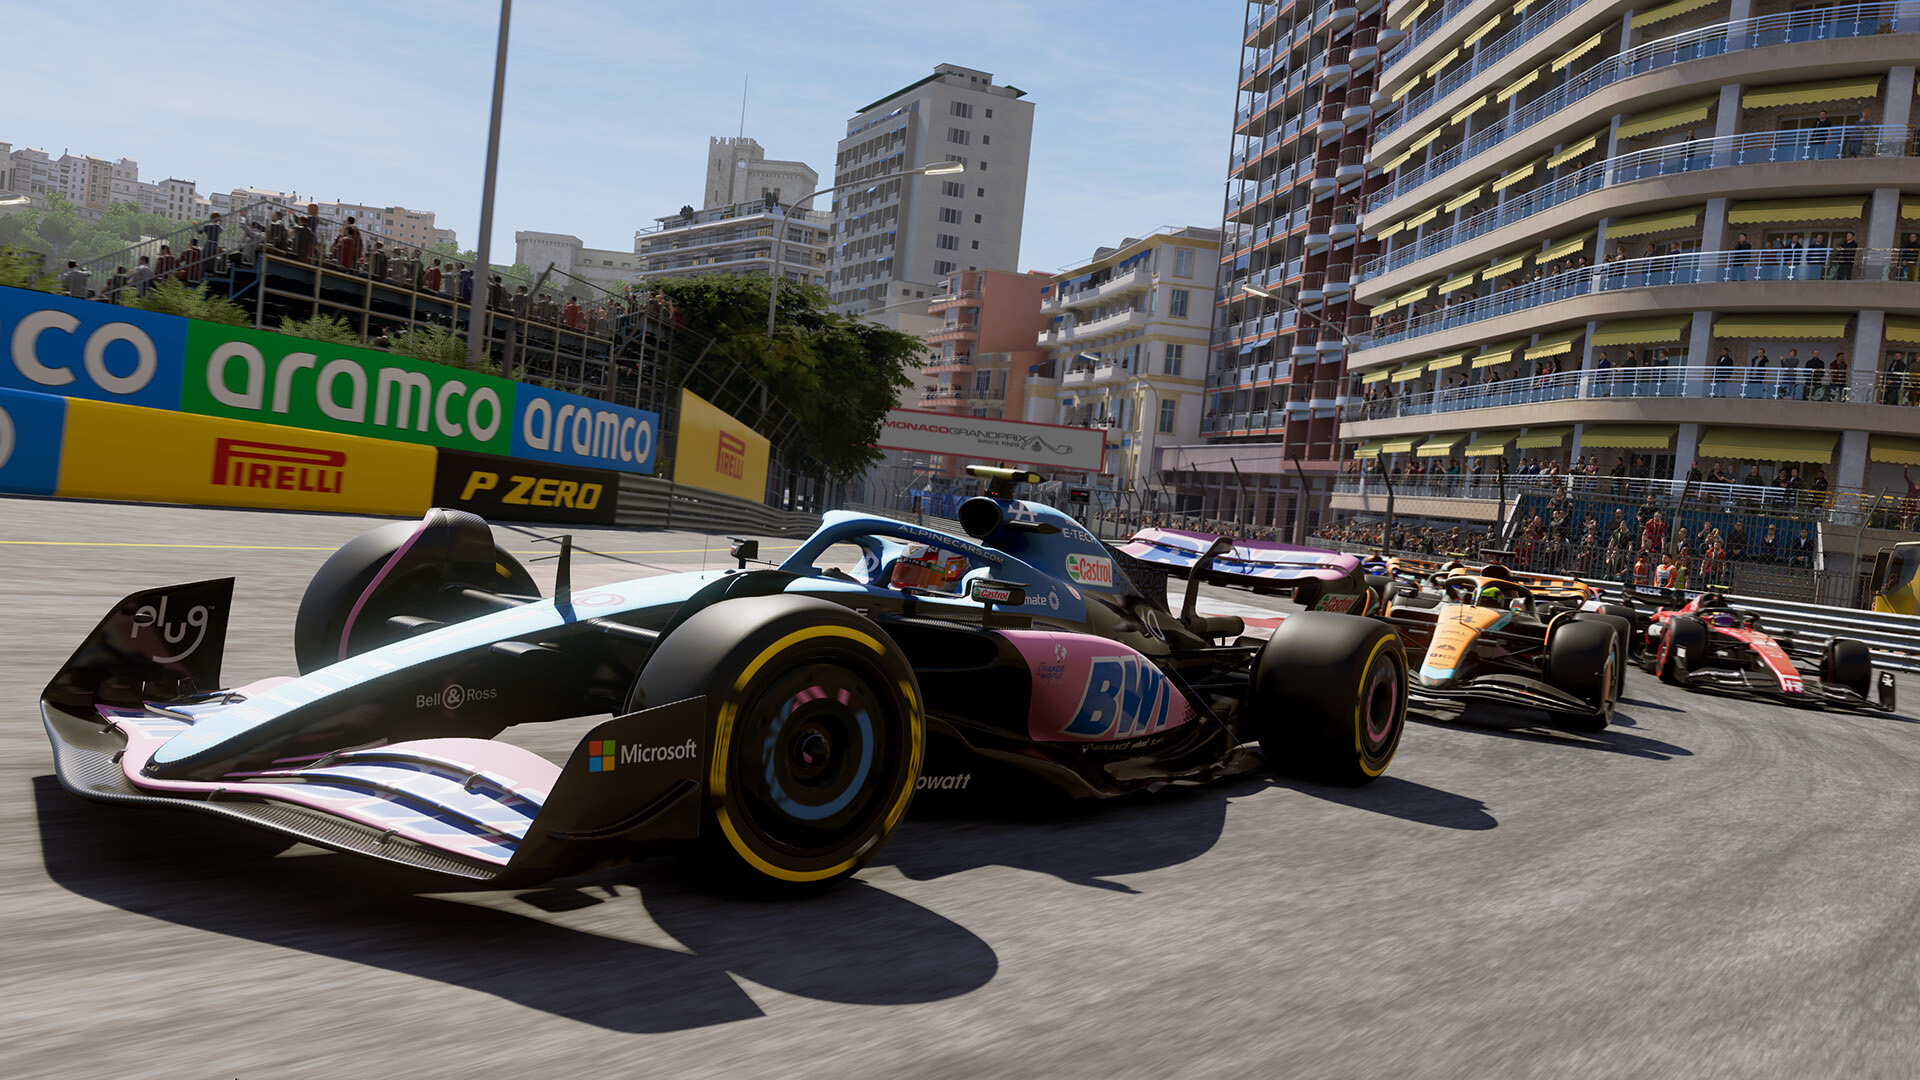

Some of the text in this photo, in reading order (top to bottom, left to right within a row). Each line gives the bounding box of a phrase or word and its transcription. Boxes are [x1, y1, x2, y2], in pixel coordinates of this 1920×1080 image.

[0, 310, 157, 395] co
[207, 341, 500, 442] aramco
[523, 397, 651, 464] aramco
[211, 437, 347, 494] PIRELLI
[716, 430, 746, 480] PIRELLI
[461, 471, 603, 510] P ZERO
[897, 525, 1004, 565] ALPINECARS.COM
[1080, 558, 1112, 583] Castrol
[980, 589, 1009, 600] Castrol
[1024, 594, 1047, 605] mate
[1323, 596, 1357, 612] Castrol
[1635, 586, 1662, 596] KICK
[131, 595, 209, 664] plug
[416, 692, 441, 708] Bell
[466, 688, 498, 702] Ross
[620, 738, 697, 764] Microsoft
[916, 773, 972, 790] owatt
